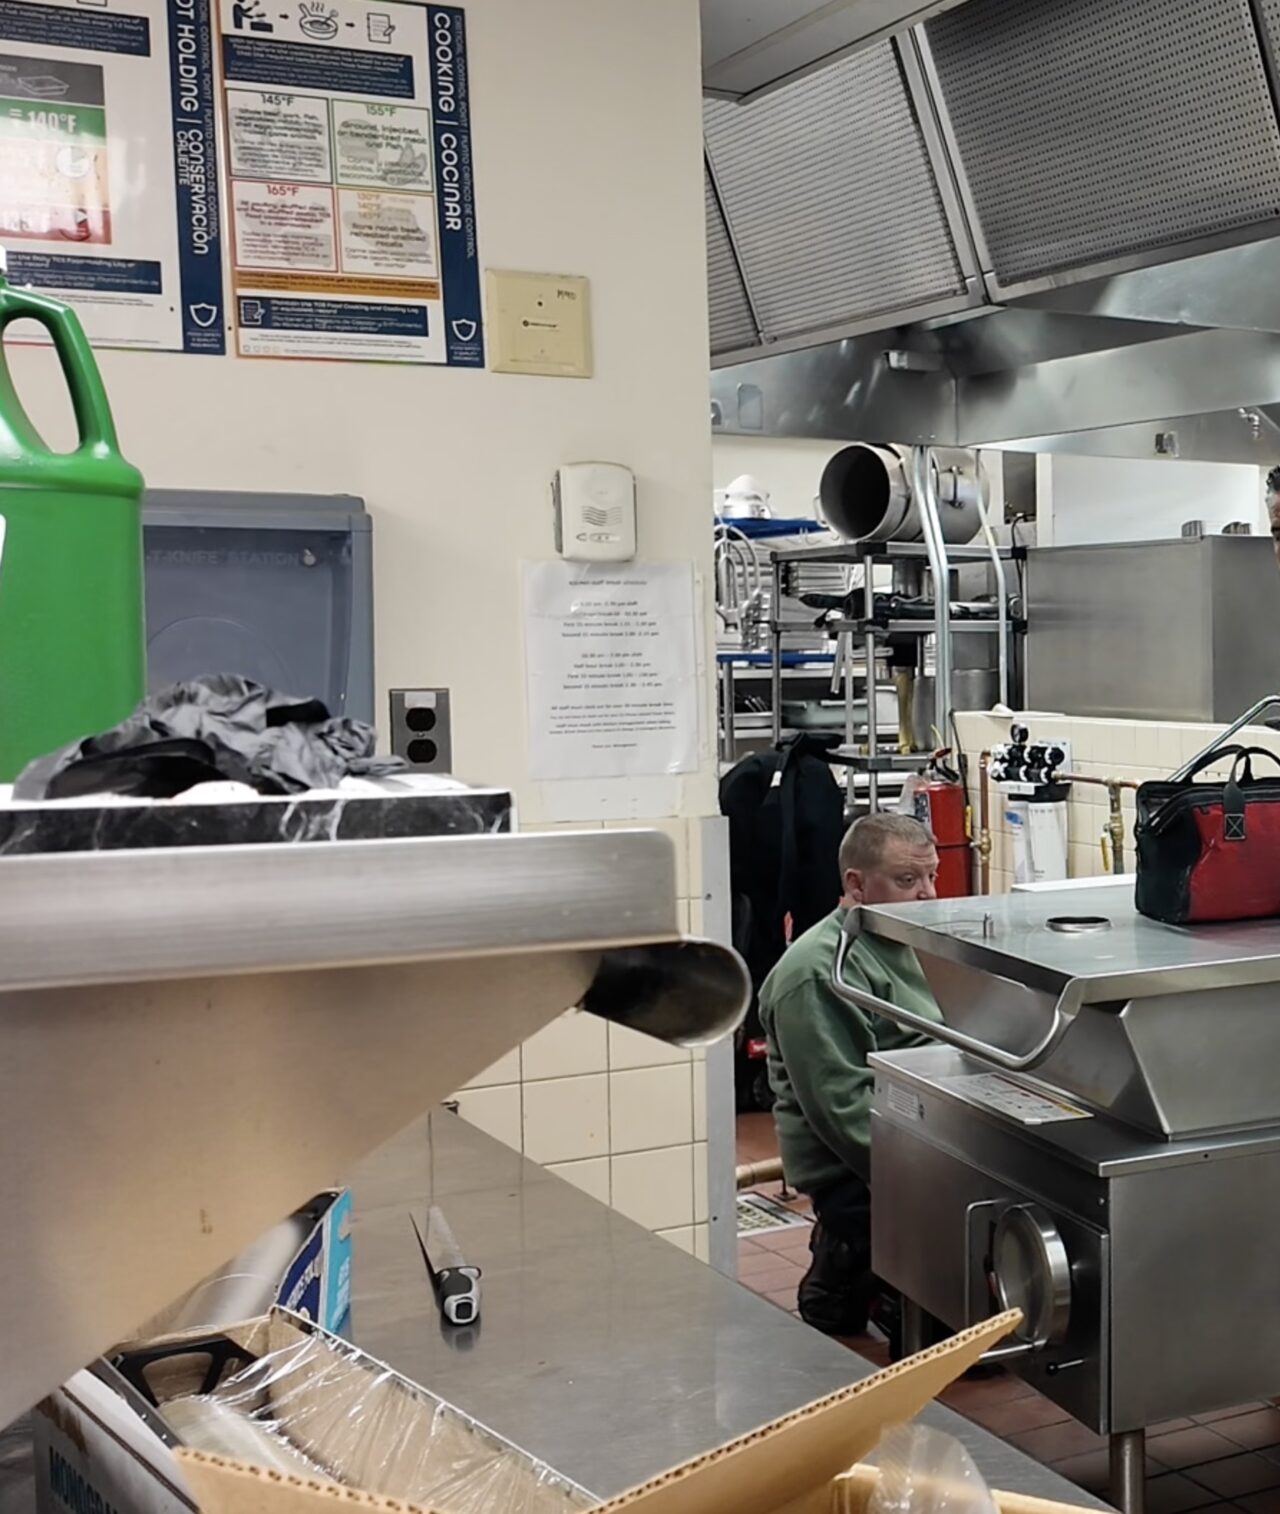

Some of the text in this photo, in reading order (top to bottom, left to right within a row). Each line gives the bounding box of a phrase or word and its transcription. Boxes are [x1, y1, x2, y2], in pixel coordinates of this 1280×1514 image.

[176, 0, 195, 19] OT
[177, 24, 199, 112] HOLDING
[434, 12, 456, 113] COOKING
[266, 184, 299, 197] 165°F
[440, 133, 462, 231] COCINAR
